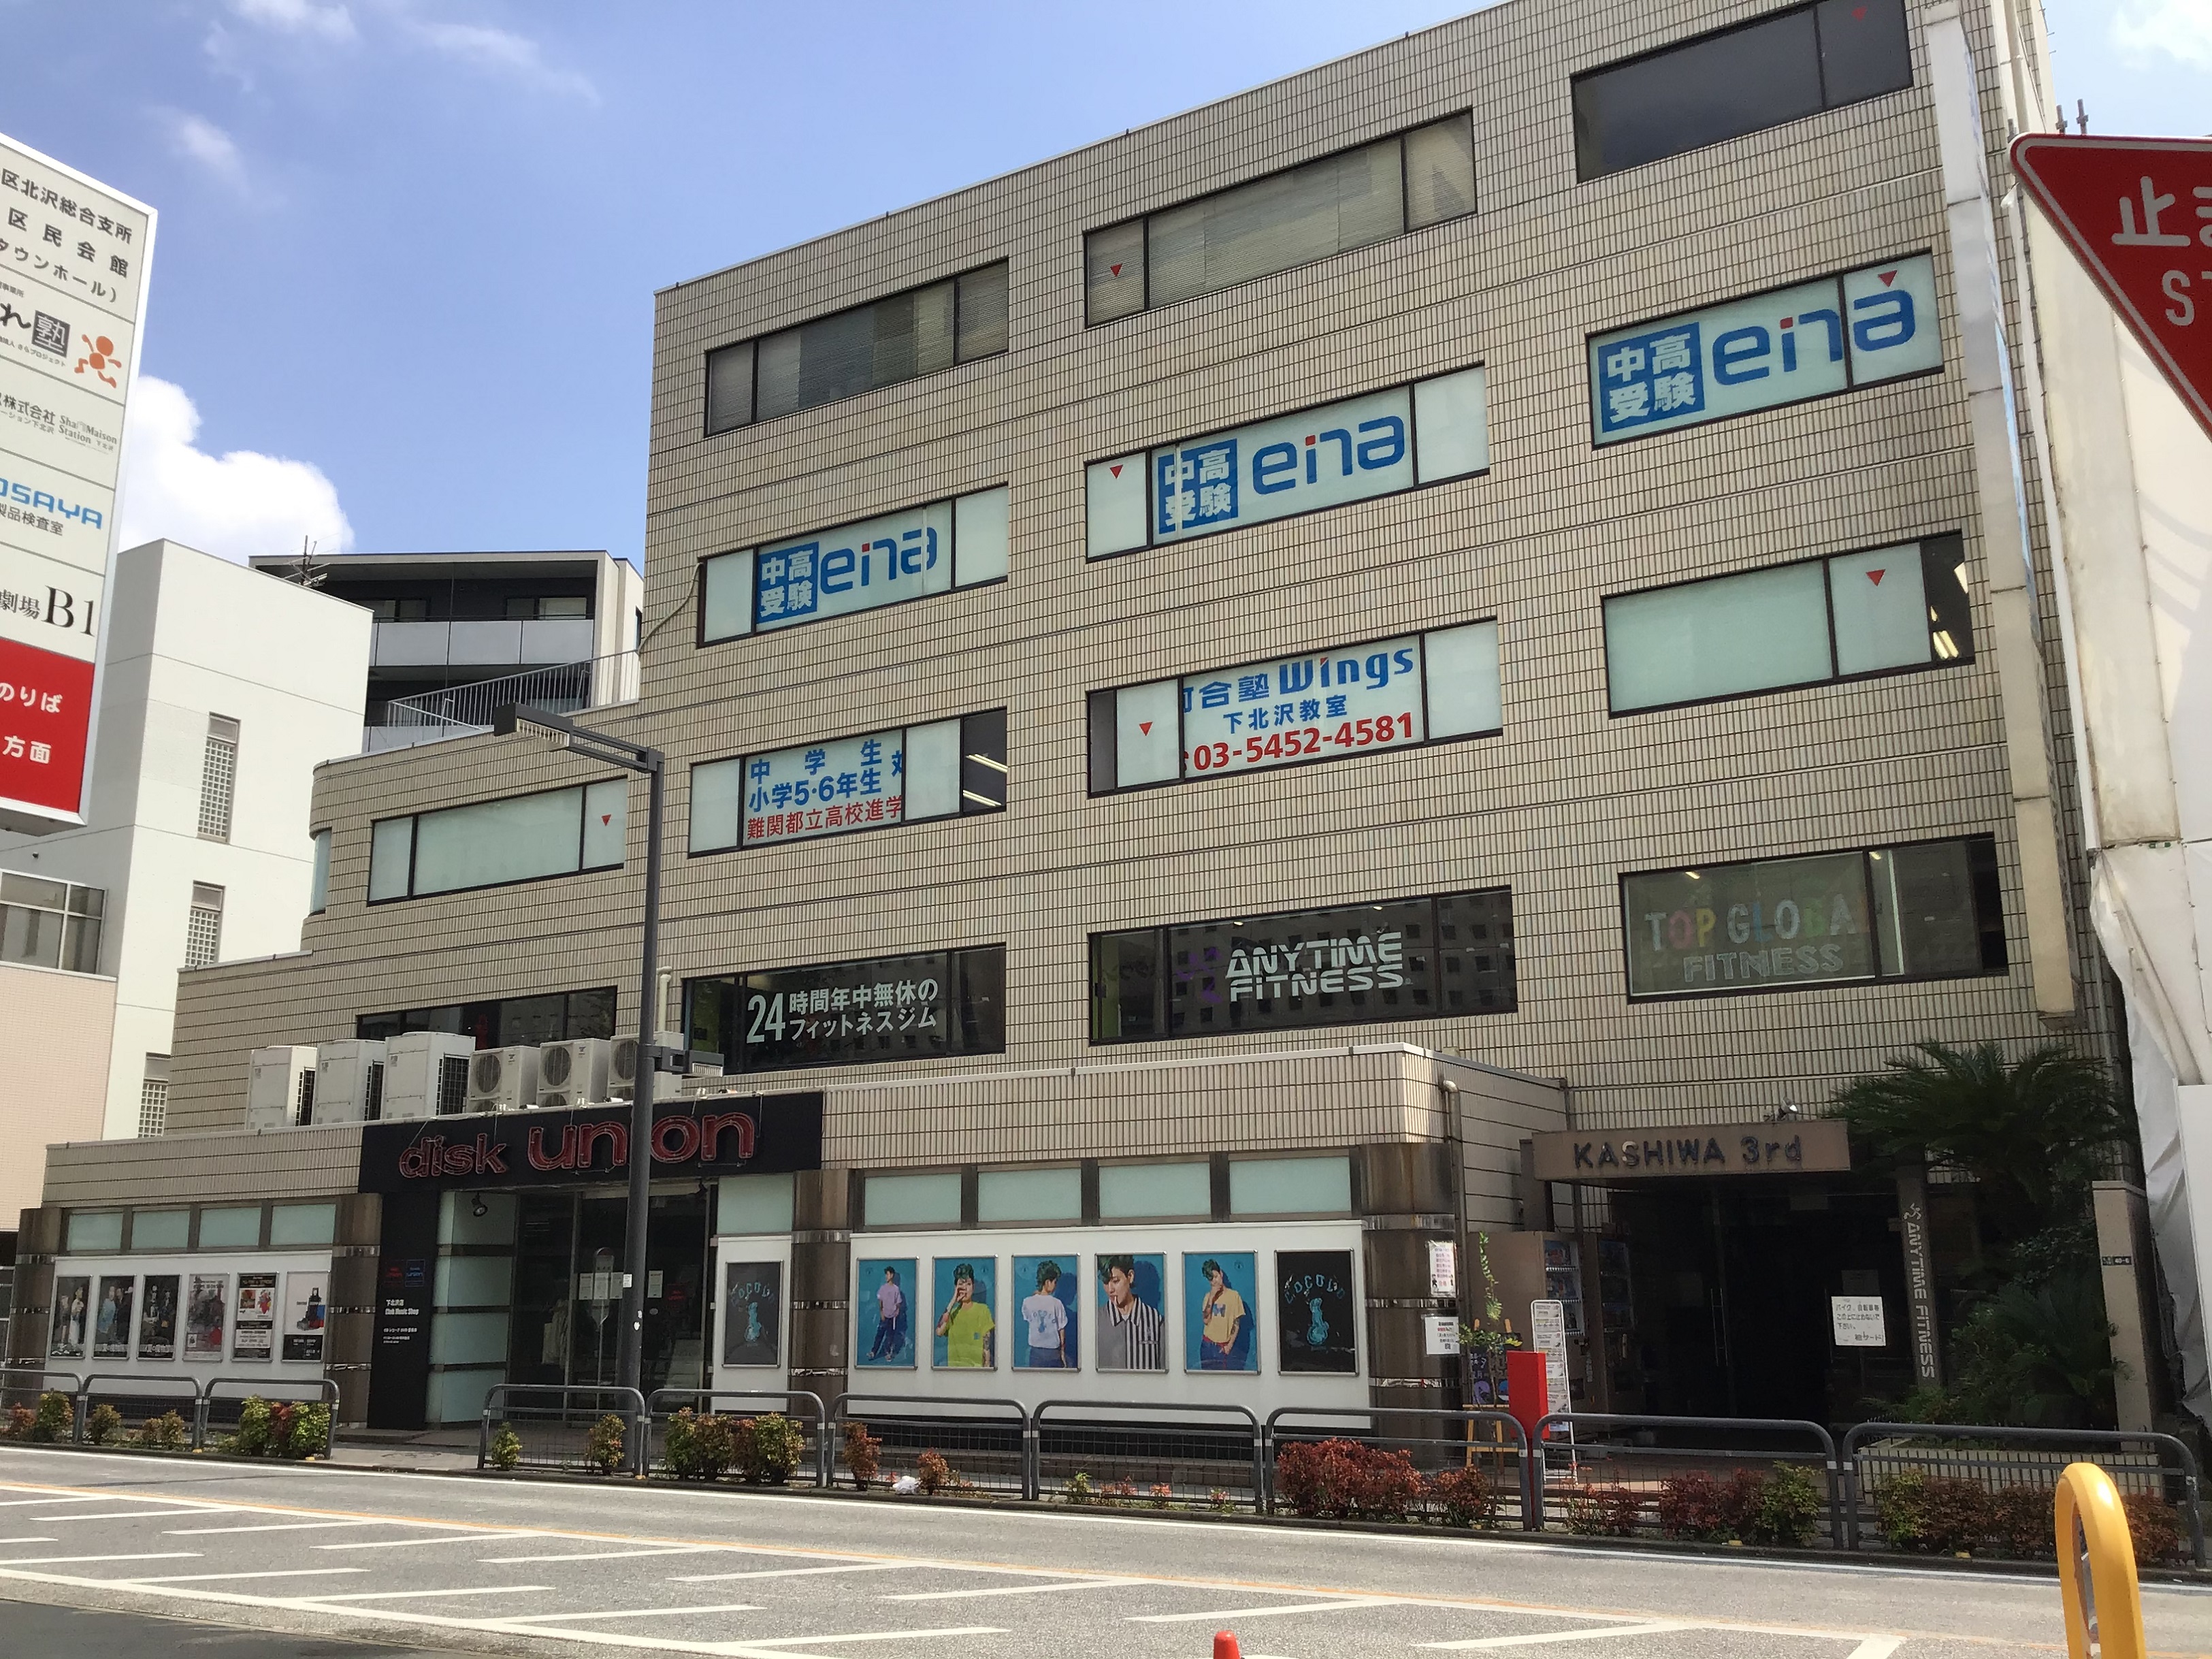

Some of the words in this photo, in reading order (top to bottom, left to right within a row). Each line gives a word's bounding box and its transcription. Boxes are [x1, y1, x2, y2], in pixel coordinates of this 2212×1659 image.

[1, 169, 131, 244] 区北沢総合支所
[2111, 176, 2212, 247] 止
[8, 206, 129, 278] 区民会館
[2162, 270, 2212, 326] S
[1607, 332, 1691, 383] 中高
[0, 393, 56, 425] 株式会社
[1609, 372, 1695, 423] 受験
[59, 425, 91, 444] Station
[762, 549, 813, 585] 中高
[760, 581, 813, 617] 受験
[1279, 648, 1414, 695] Wings
[0, 683, 63, 713] のりば
[1223, 694, 1348, 735] 下北沢教室
[3, 736, 52, 764] 方面
[1194, 712, 1412, 771] 03-5452-4581
[747, 794, 902, 840] 難関都立高校進学
[1644, 907, 1716, 952] TOP
[1226, 932, 1402, 980] ANYTIME
[1683, 944, 1844, 982] FITNESS
[1231, 963, 1403, 1002] FITNESS
[746, 993, 786, 1044] 24
[790, 978, 938, 1015] 時間年中無休の
[790, 1006, 937, 1041] フィットネスジム
[398, 1133, 508, 1178] disk
[527, 1112, 755, 1170] unon
[1574, 1138, 1726, 1169] KASHIWA
[1740, 1135, 1802, 1165] 3rd
[1907, 1222, 1927, 1300] ANYTIME
[1915, 1305, 1935, 1379] FITNESS
